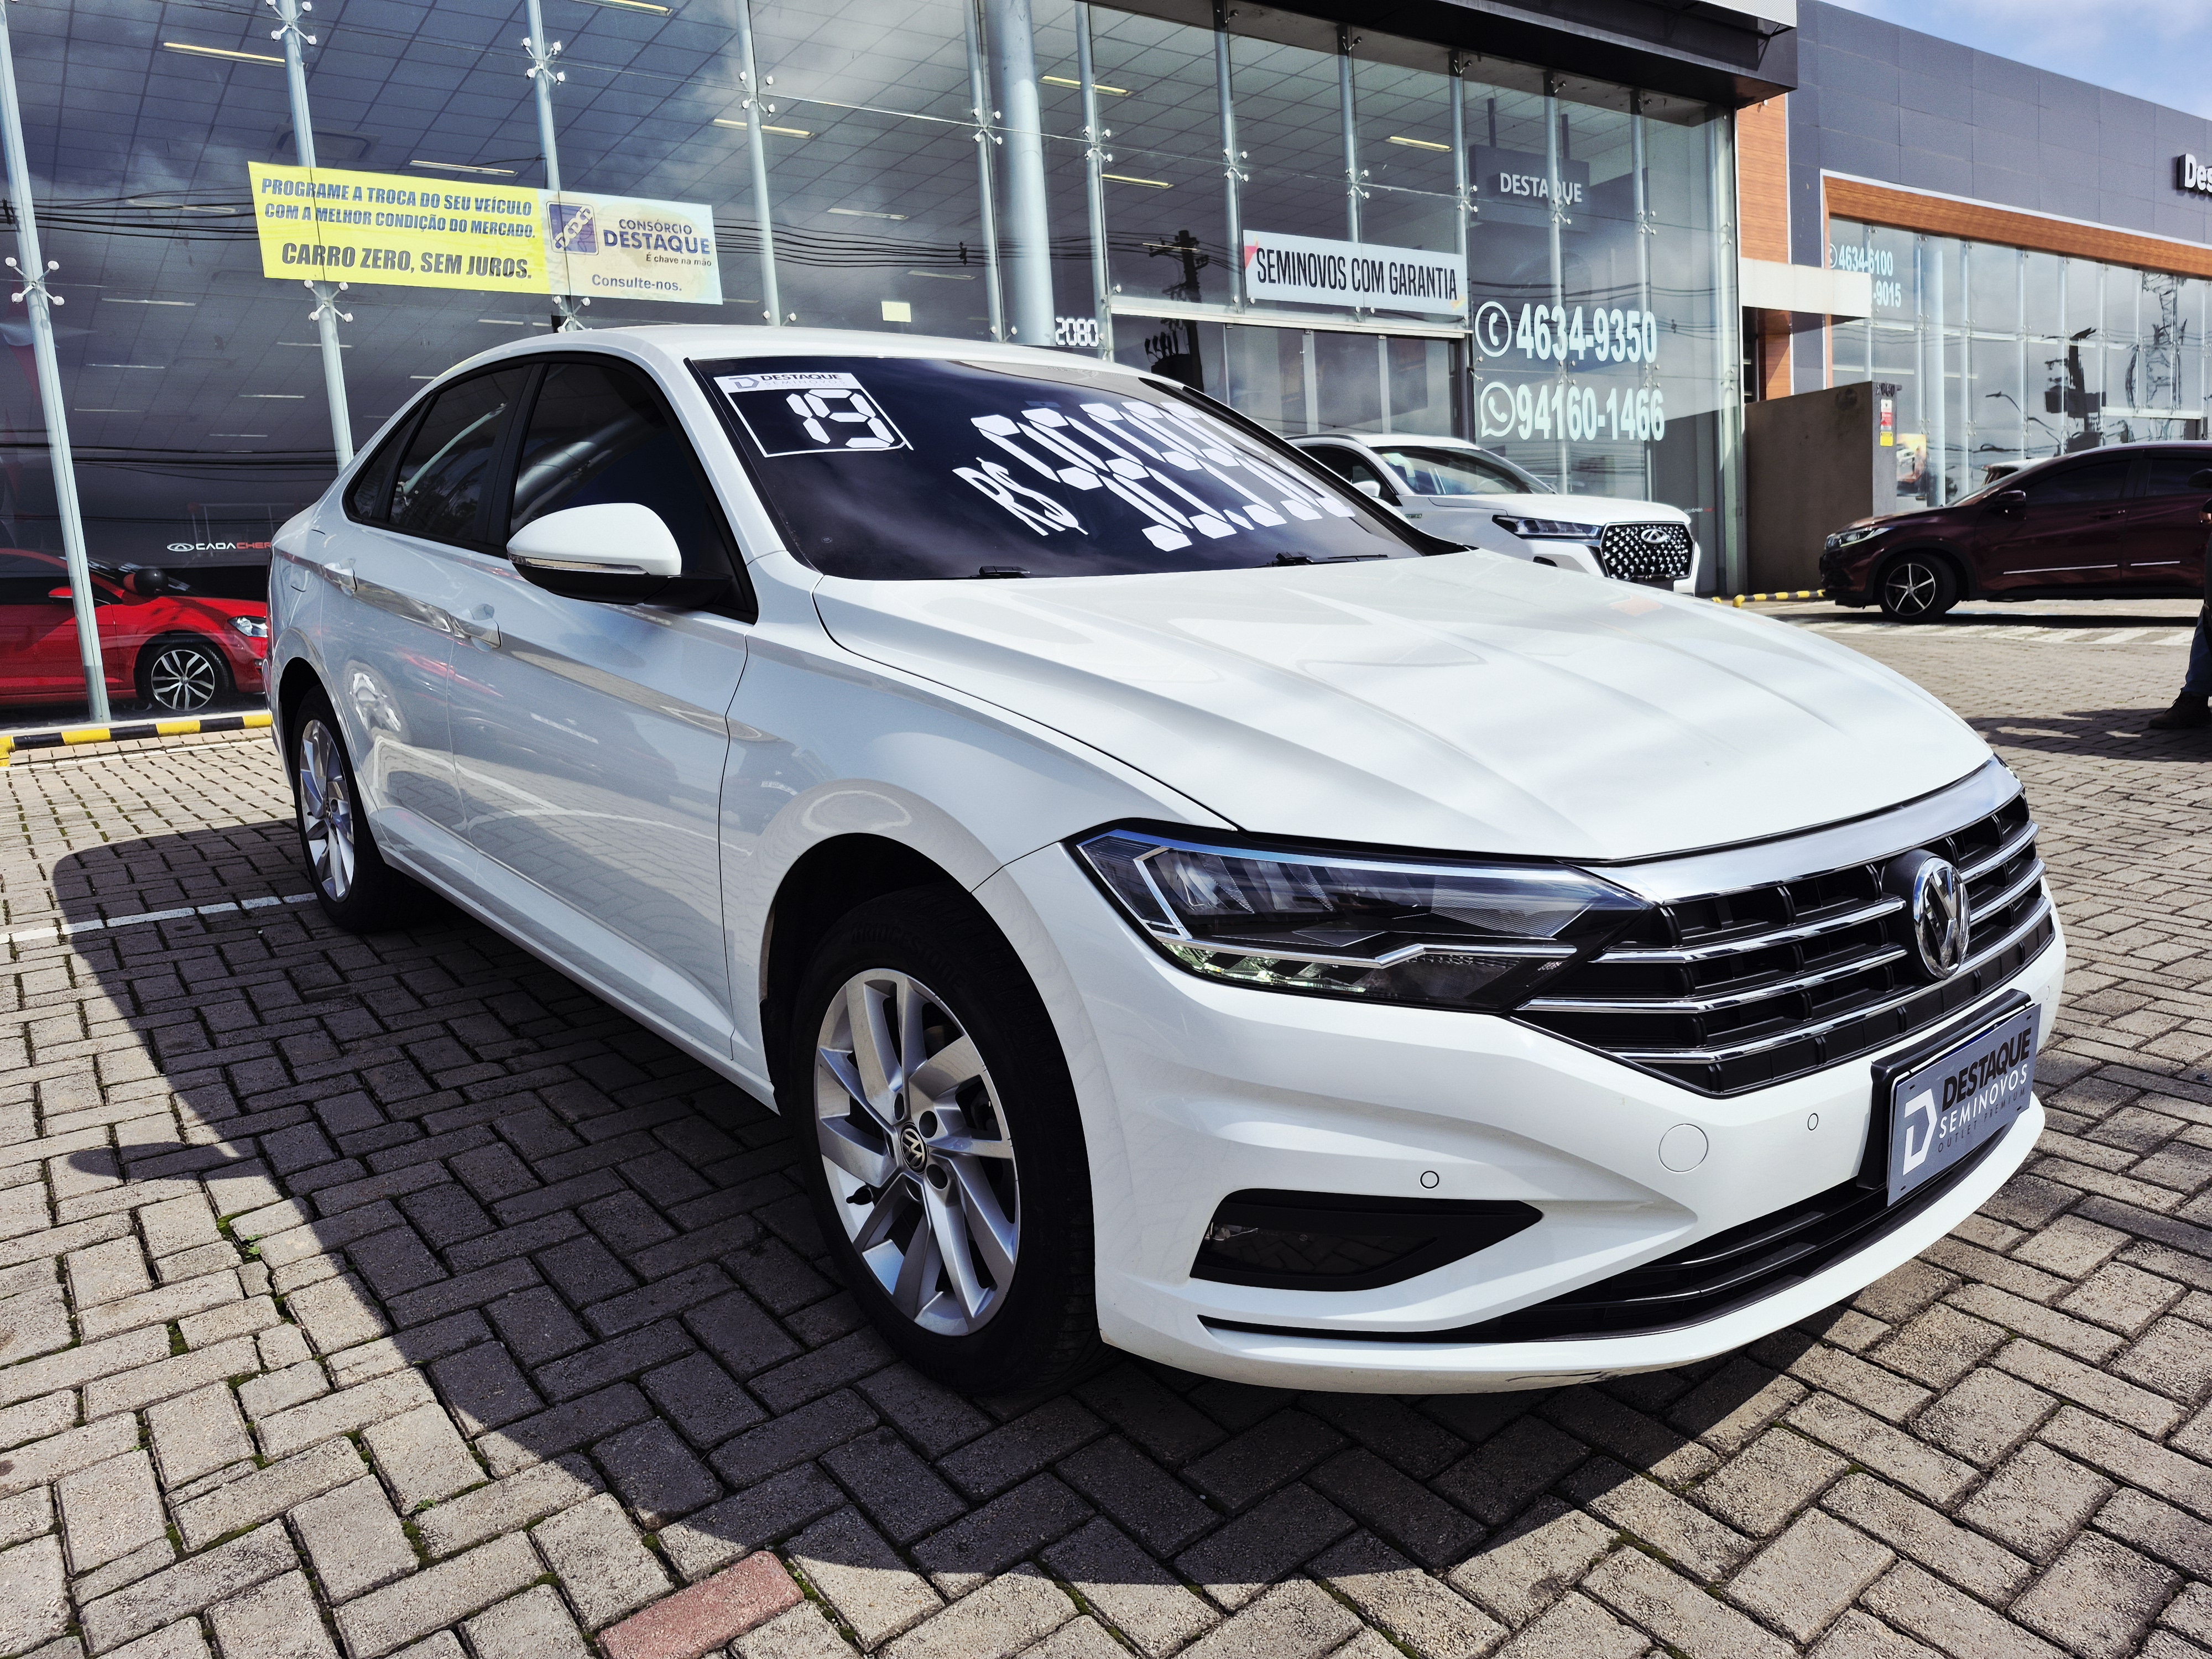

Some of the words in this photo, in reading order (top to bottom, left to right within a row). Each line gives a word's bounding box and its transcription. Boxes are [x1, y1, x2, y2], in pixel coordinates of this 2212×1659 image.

[261, 178, 349, 200] PROGRAME
[352, 186, 363, 202] A
[367, 187, 416, 206] TROCA
[420, 192, 440, 208] DO
[444, 195, 471, 211] SEU
[474, 196, 532, 216] VEÍCULO
[264, 203, 299, 220] COM
[301, 206, 311, 221] A
[315, 207, 371, 226] MELHOR
[375, 212, 446, 232] CONDIÇÃO
[449, 218, 467, 233] DO
[471, 220, 535, 238] MERCADO.
[619, 218, 692, 235] CONSÓRCIO
[603, 229, 710, 254] DESTAQUE
[646, 252, 653, 262] É
[654, 255, 679, 264] chave
[694, 256, 712, 267] mão
[1838, 244, 1893, 276] 4634-6100
[282, 243, 356, 268] CARRO
[359, 248, 415, 274] ZERO,
[420, 252, 463, 275] SEM
[466, 256, 532, 279] JUROS.
[1256, 248, 1347, 291] SEMINOVOS
[1351, 258, 1385, 294] COM
[1389, 262, 1458, 300] GARANTIA
[592, 274, 682, 291] Consulte-nos.
[1055, 317, 1099, 347] 2080
[1516, 303, 1657, 363] 4634-9350
[786, 389, 895, 448] 19
[1516, 384, 1665, 441] 94160-1466
[952, 457, 1088, 536] R$
[1942, 1027, 2032, 1112] DESTAQUE
[1938, 1120, 1978, 1152] OUTLET
[1984, 1087, 2025, 1122] PREMIUM
[1939, 1063, 2028, 1139] SEMINOVOS
